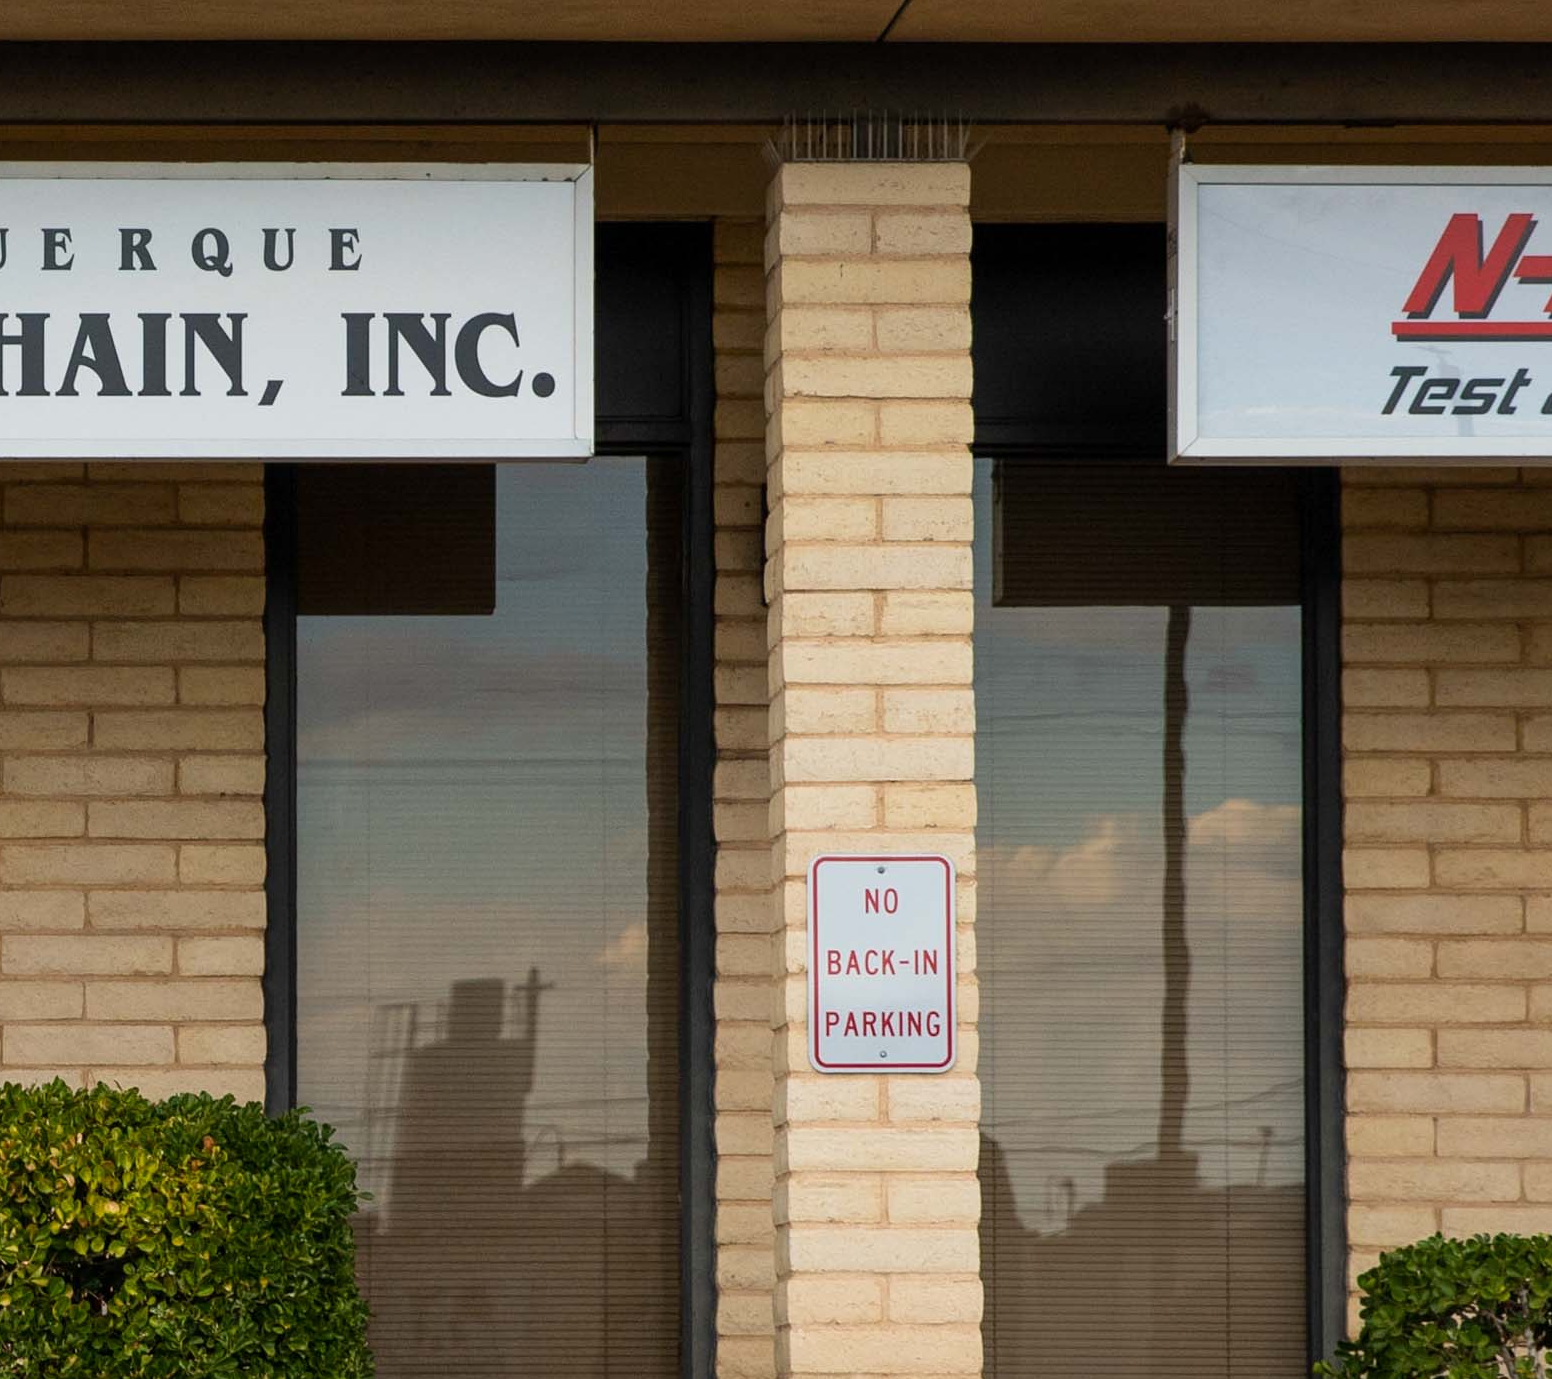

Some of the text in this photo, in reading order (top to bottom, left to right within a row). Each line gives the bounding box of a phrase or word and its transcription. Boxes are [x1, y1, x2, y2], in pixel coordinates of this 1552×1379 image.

[341, 313, 555, 397] INC.
[1382, 366, 1532, 415] Test
[865, 888, 899, 914] NO
[827, 949, 939, 976] BACK-IN
[825, 1010, 941, 1038] PARKING
